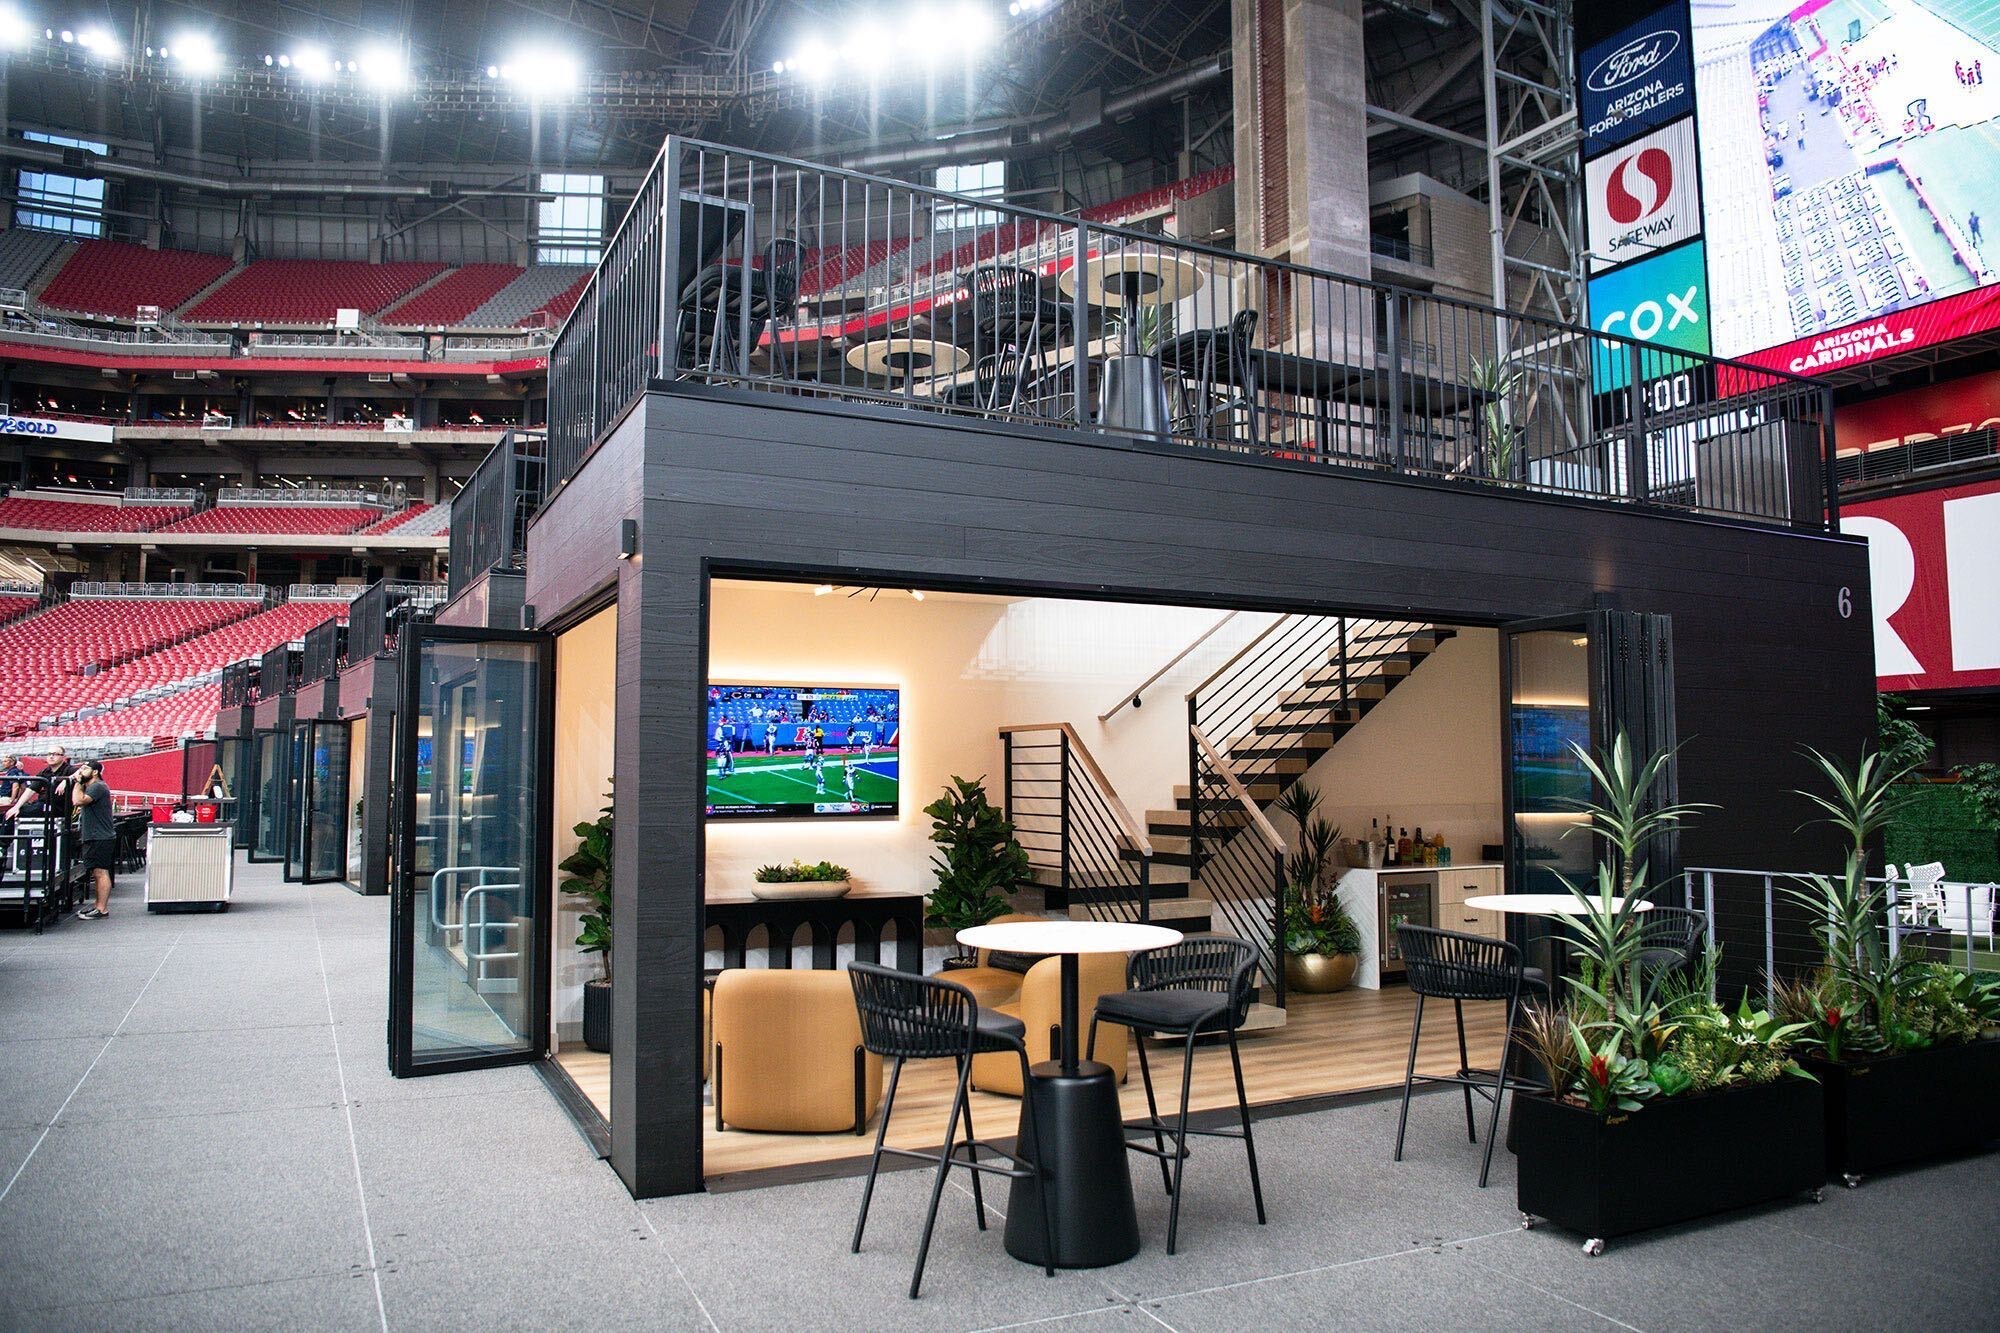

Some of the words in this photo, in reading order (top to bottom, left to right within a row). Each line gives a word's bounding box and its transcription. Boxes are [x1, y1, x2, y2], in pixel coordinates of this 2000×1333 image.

[1604, 40, 1661, 86] Ford
[1606, 79, 1664, 116] ARIZONA
[1624, 82, 1685, 119] DEALERS
[1600, 285, 1699, 350] COX
[1789, 327, 1916, 373] CARDINALS
[1812, 322, 1888, 353] ARIZONA
[1838, 586, 1852, 619] 6
